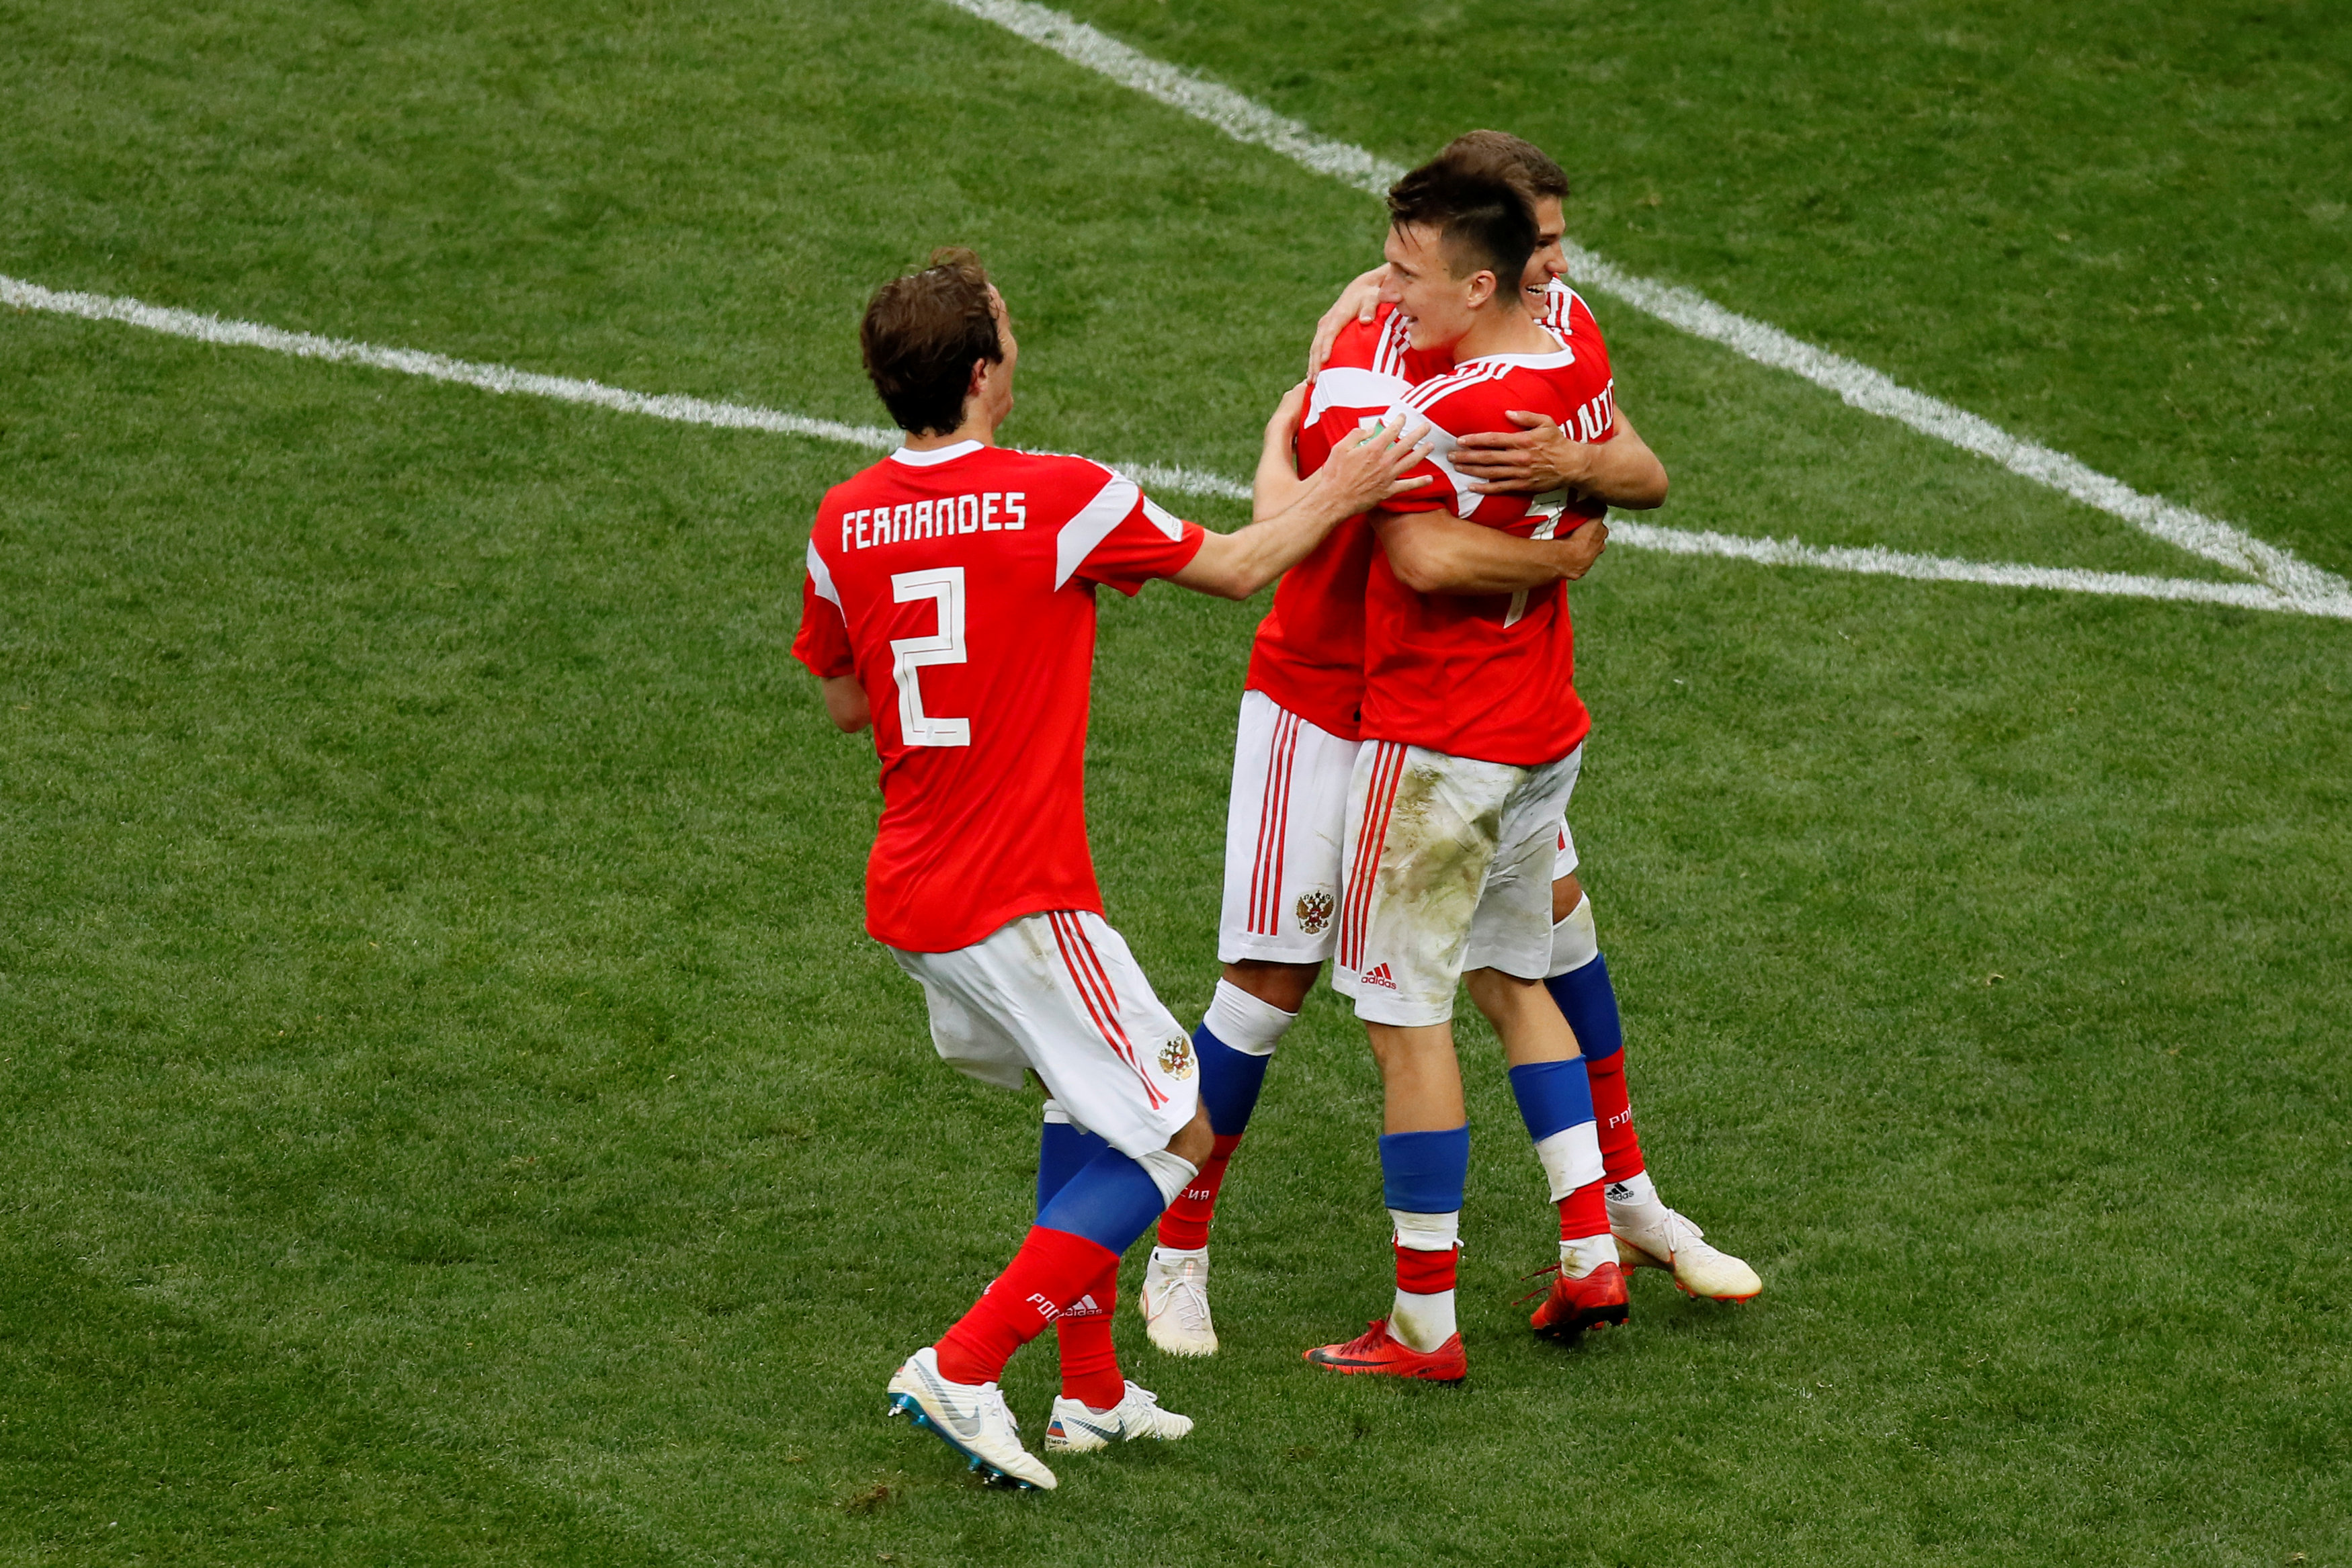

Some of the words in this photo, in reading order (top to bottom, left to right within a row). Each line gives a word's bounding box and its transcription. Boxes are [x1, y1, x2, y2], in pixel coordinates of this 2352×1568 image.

[842, 492, 1026, 552] FERNANDES
[890, 566, 970, 747] 2
[1361, 975, 1396, 990] adidas
